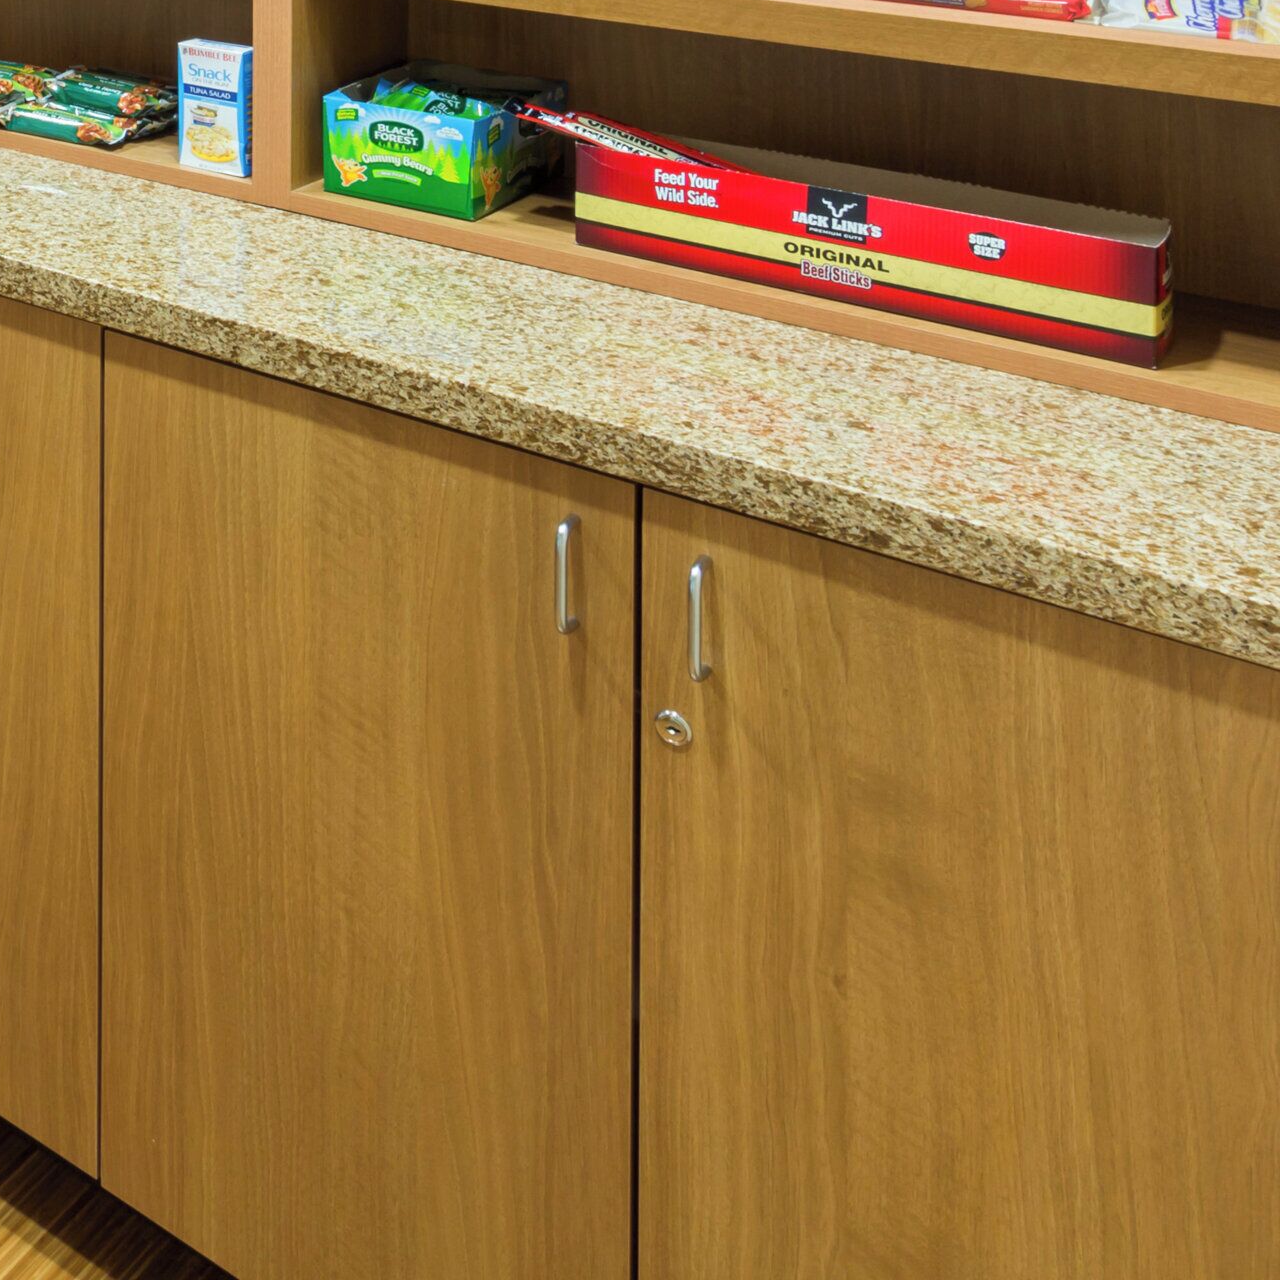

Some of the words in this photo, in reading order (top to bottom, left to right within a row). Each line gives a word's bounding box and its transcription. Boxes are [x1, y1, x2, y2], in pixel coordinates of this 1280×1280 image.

[187, 47, 221, 60] BUMBLE
[223, 51, 239, 63] BEE
[188, 62, 232, 83] Snack
[189, 86, 206, 95] TUNA
[208, 88, 231, 100] SALAD
[373, 130, 419, 147] FOREST
[376, 123, 416, 138] BLACK
[361, 152, 402, 167] Gummy
[403, 158, 434, 176] Bears
[654, 168, 686, 187] Feed
[689, 172, 720, 191] Your
[654, 185, 686, 204] Wild
[687, 191, 720, 209] Side.
[792, 210, 829, 229] JACK
[831, 219, 883, 239] LINK'S
[808, 226, 842, 238] PREMIUM
[844, 233, 865, 242] CUTS
[968, 232, 1007, 250] SUPER
[783, 241, 891, 273] ORIGINAL
[972, 243, 1002, 260] SIZE
[801, 260, 831, 280] Beef
[832, 265, 872, 290] Sticks
